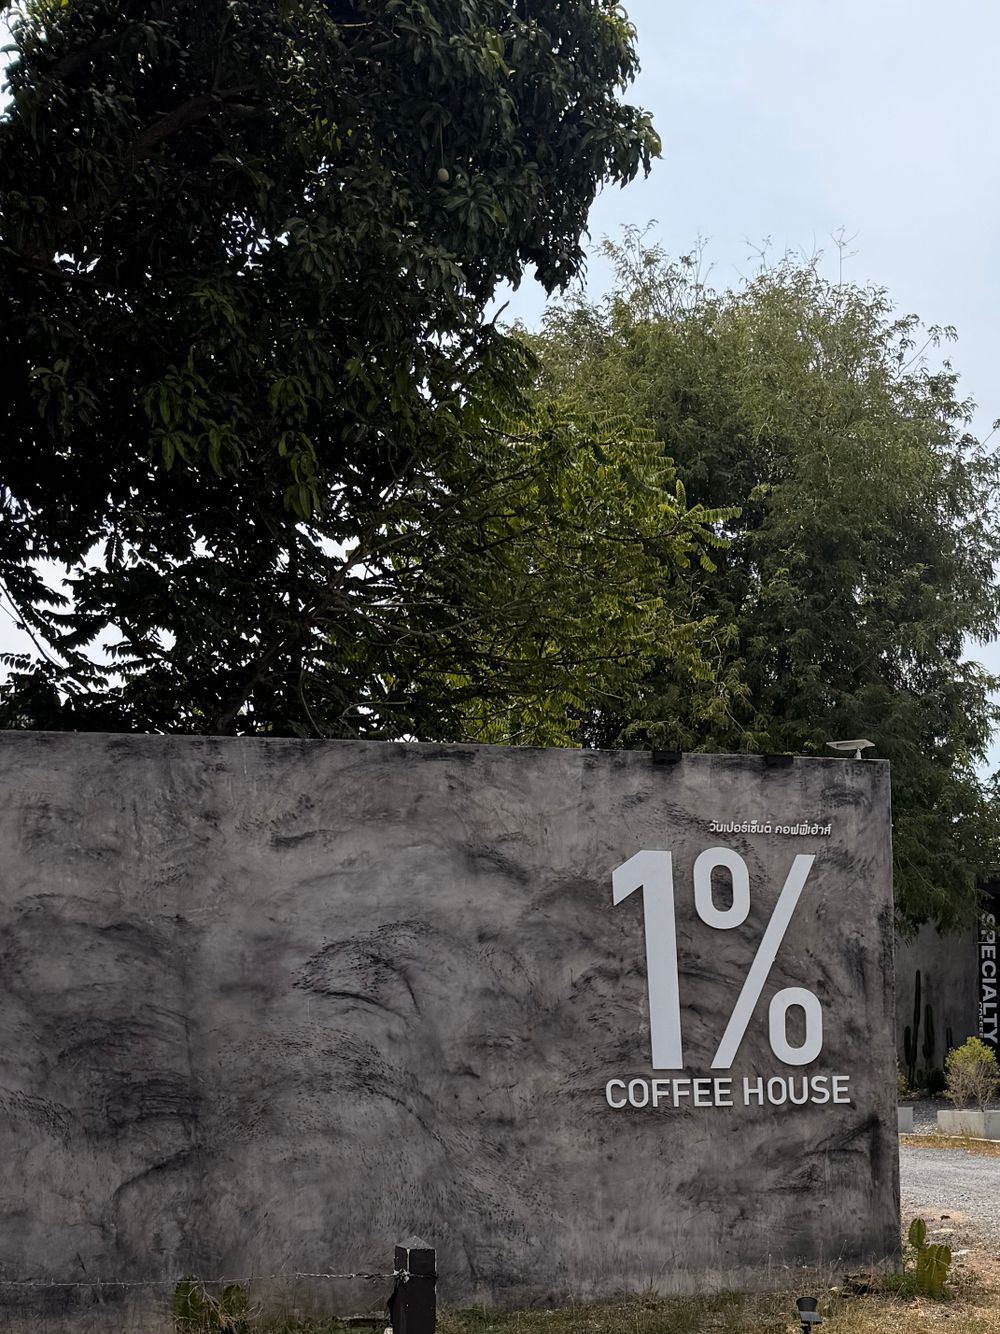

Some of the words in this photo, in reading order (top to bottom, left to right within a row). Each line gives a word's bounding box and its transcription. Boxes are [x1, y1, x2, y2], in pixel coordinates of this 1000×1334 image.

[611, 846, 824, 1070] 1%
[981, 913, 998, 1044] SPECIALTY
[605, 1078, 733, 1109] COFFEE
[743, 1075, 851, 1106] HOUSE
